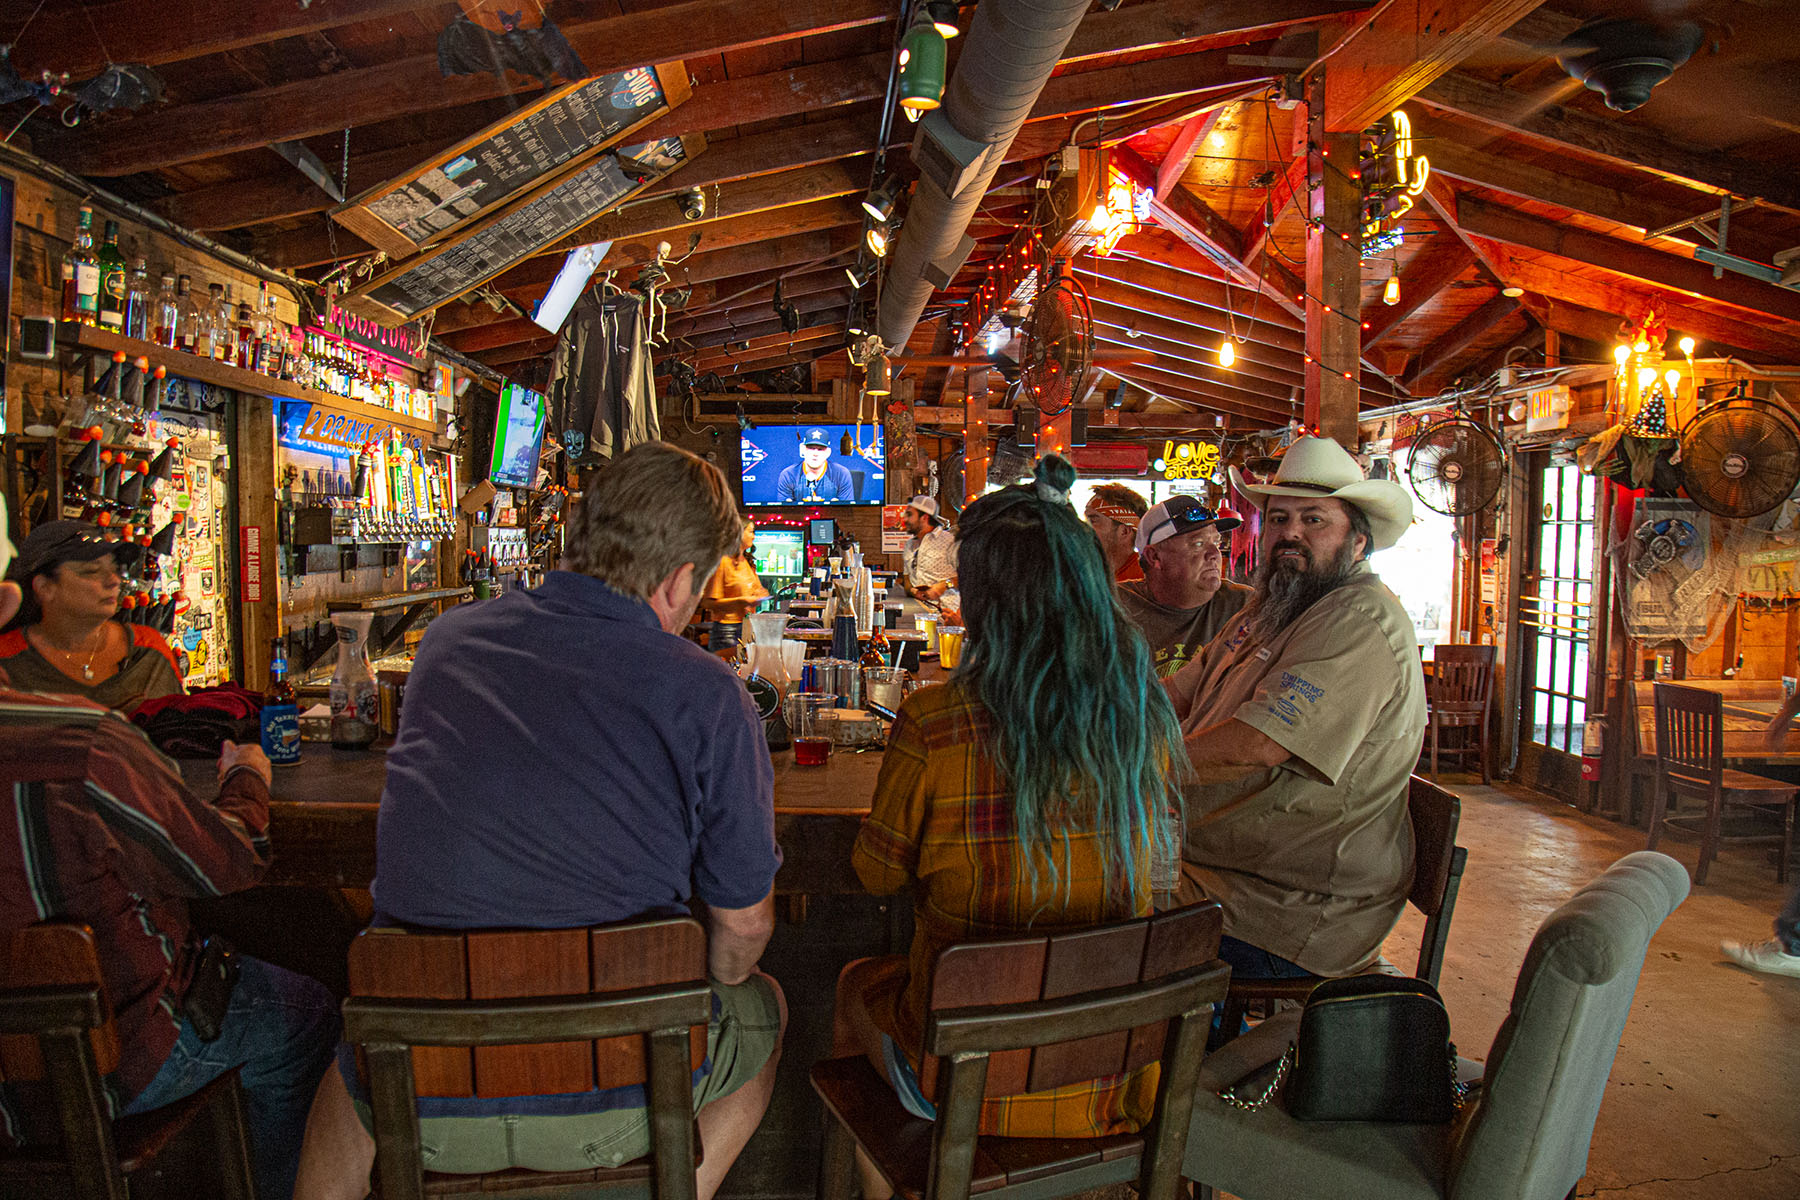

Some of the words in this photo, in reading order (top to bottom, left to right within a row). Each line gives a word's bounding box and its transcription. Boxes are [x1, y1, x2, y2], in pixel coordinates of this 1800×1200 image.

[624, 66, 656, 107] SWAG
[1532, 389, 1555, 420] EXIT
[305, 410, 321, 436] 2
[320, 414, 374, 445] DRINKS
[1154, 644, 1203, 662] EXA
[1280, 680, 1318, 703] SPRINGS
[1282, 672, 1325, 698] DRIPPING
